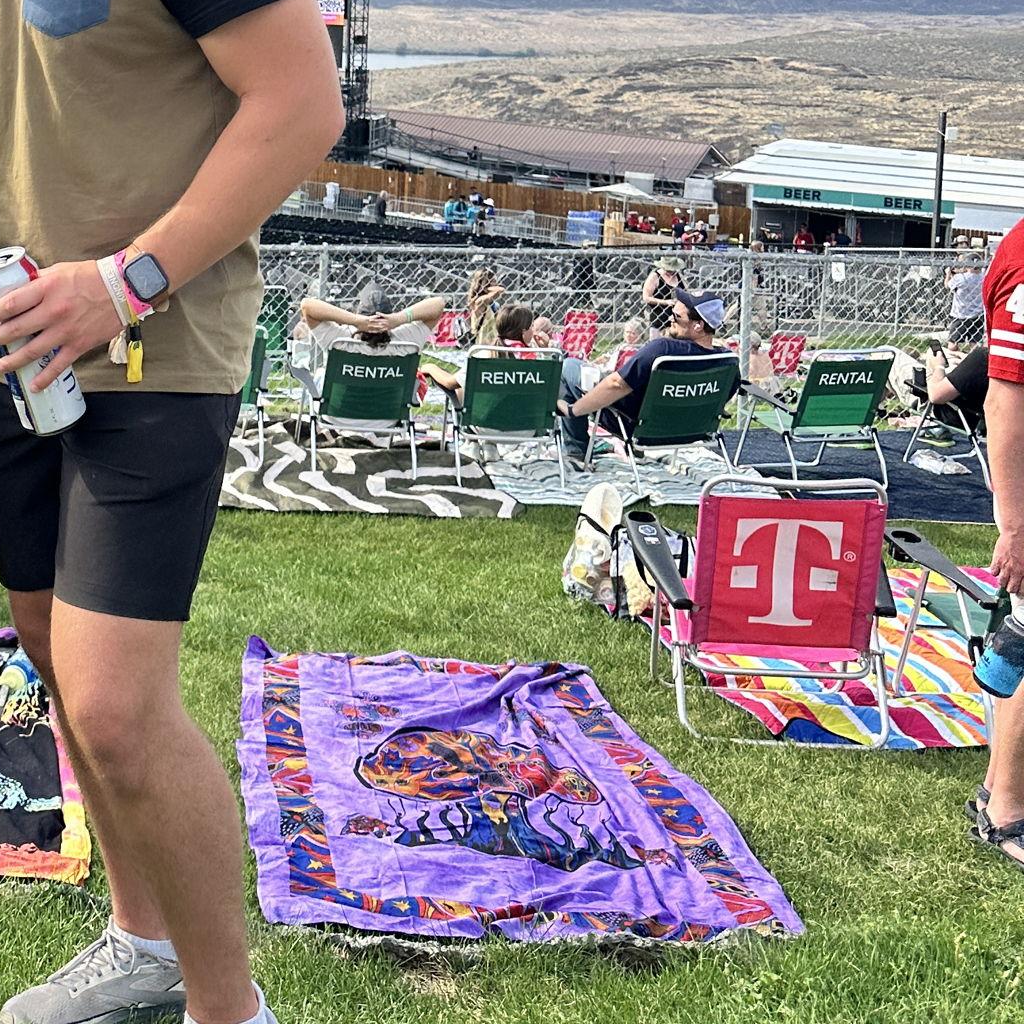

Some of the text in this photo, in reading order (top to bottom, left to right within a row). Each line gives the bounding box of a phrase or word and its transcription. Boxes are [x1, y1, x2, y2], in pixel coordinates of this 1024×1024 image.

[783, 187, 821, 201] BEER
[883, 197, 923, 210] BEER
[342, 364, 404, 378] RENTAL
[481, 370, 545, 385] RENTAL
[819, 371, 875, 386] RENTAL
[662, 380, 720, 398] RENTAL
